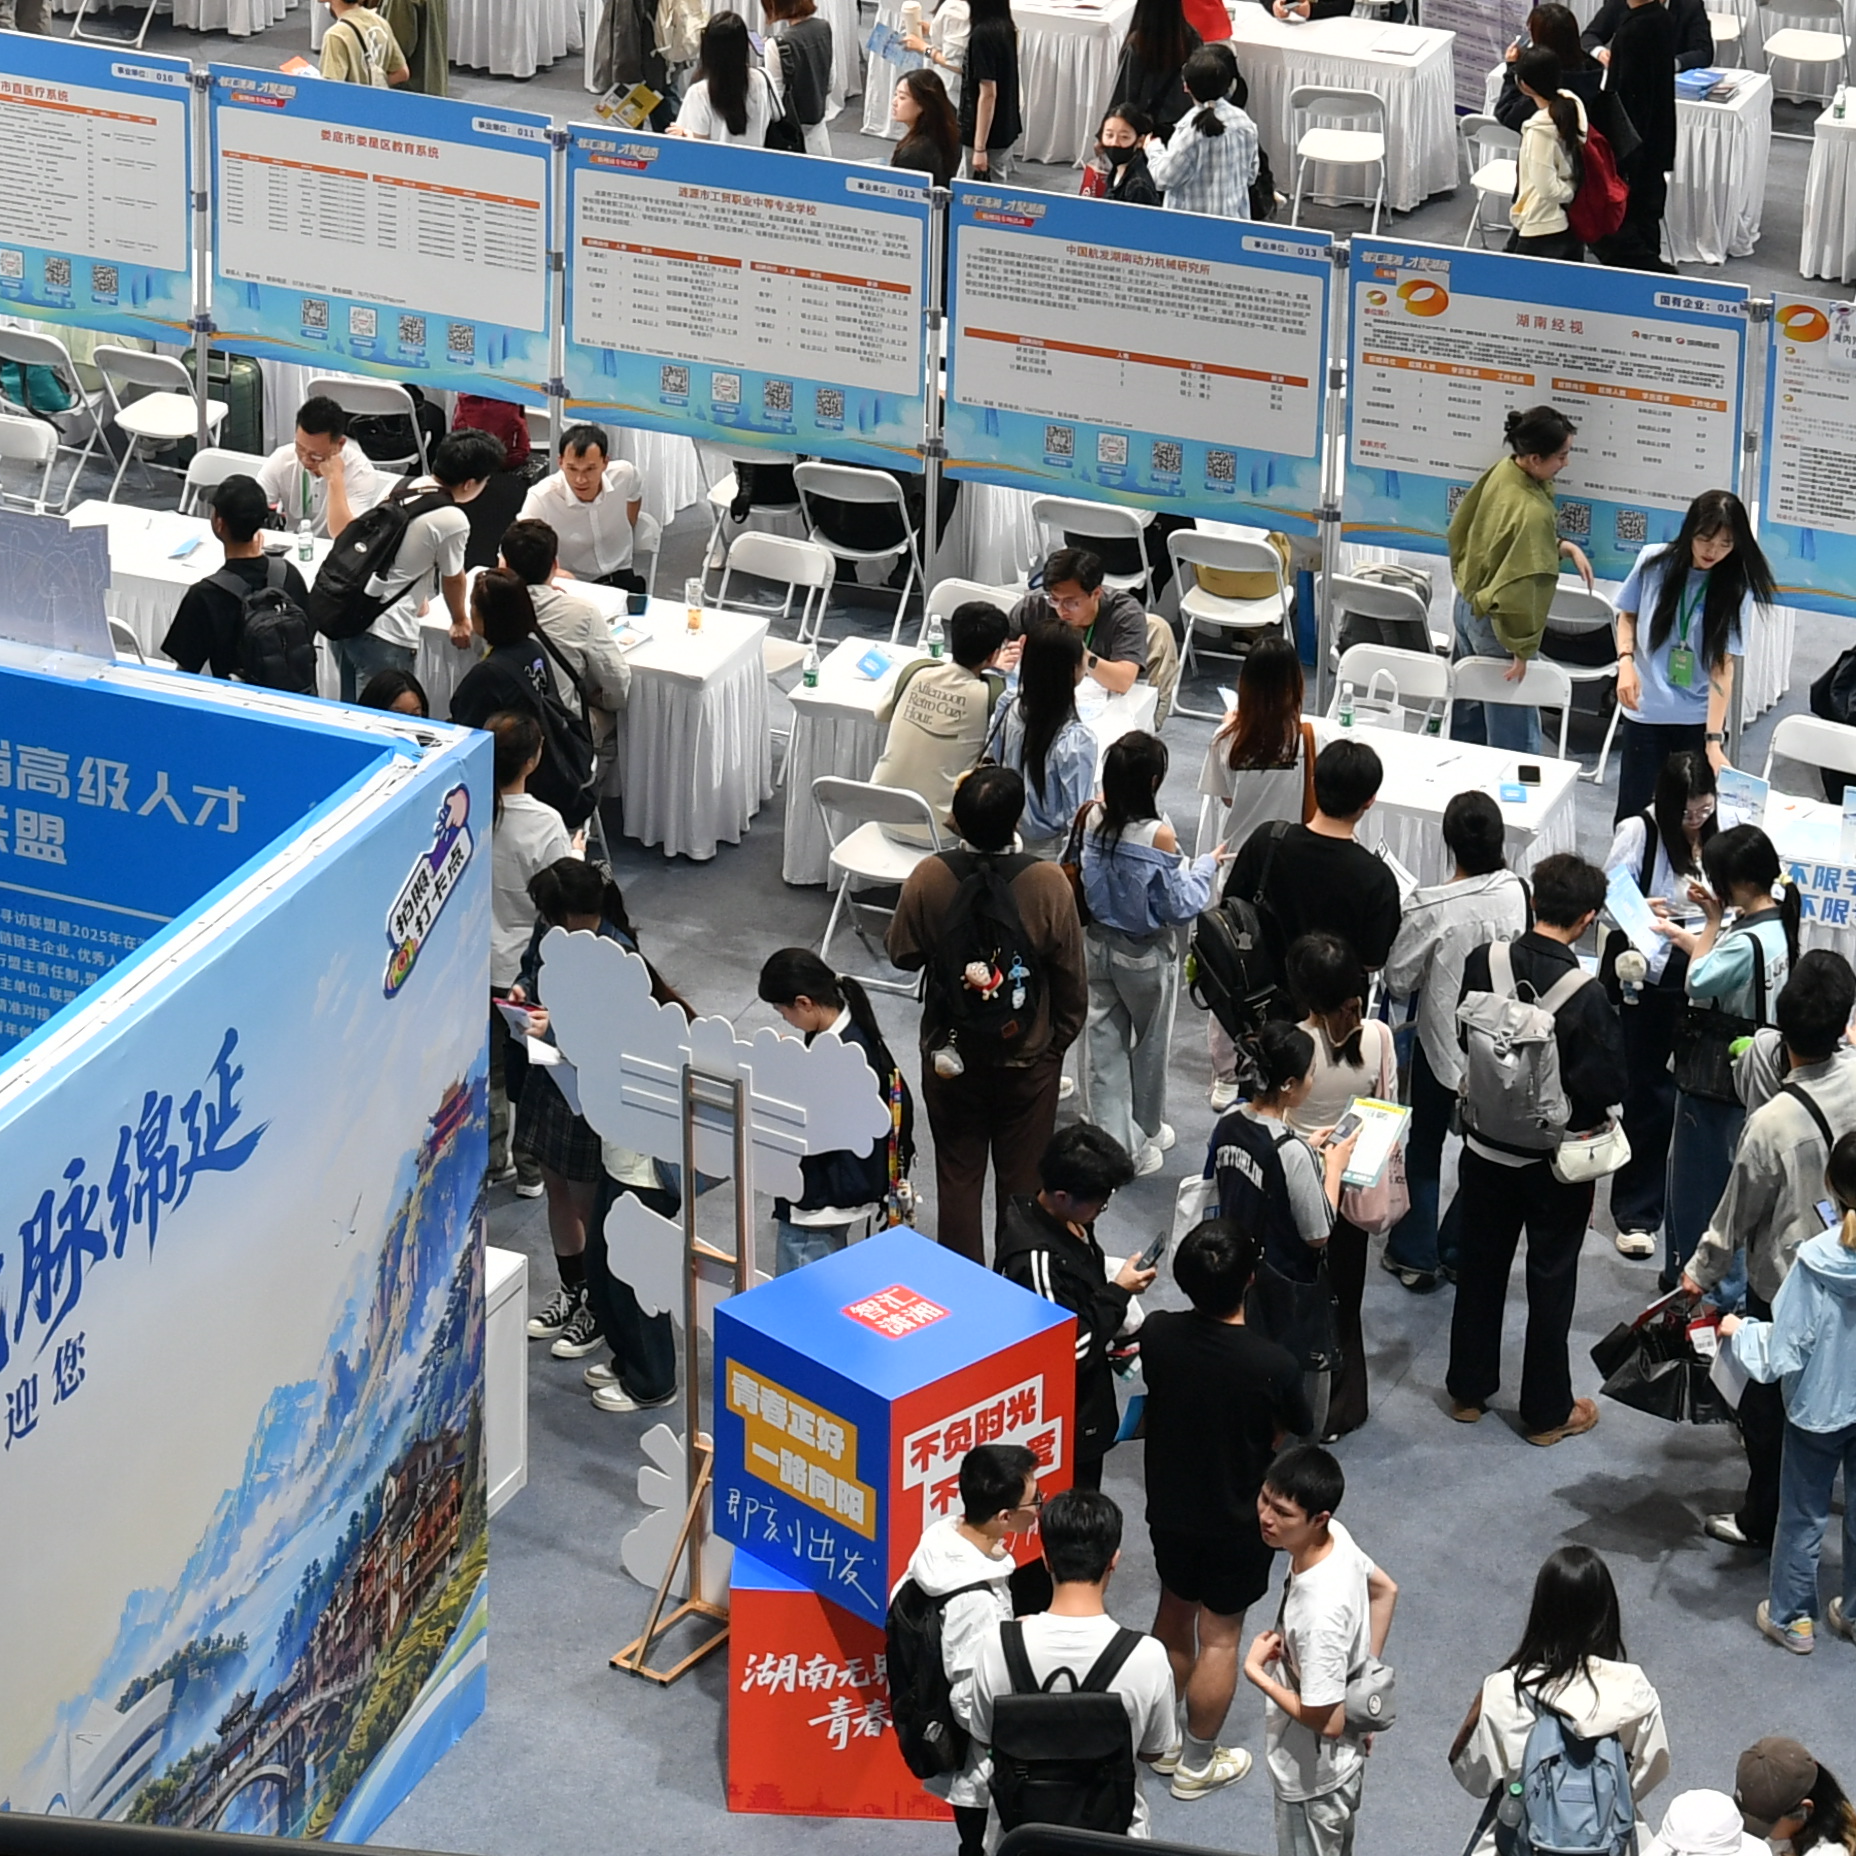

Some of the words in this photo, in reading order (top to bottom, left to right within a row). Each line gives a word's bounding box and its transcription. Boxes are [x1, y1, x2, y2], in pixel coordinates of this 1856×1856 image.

[320, 129, 440, 159] 娄底市娄星区教育系统
[678, 186, 817, 215] 涟源市工贸职业中等专业学校
[1066, 245, 1210, 275] 中国航发湖南动力机械研究所
[1516, 313, 1584, 335] 湖南经视
[1660, 294, 1738, 314] 国有企业：014
[396, 867, 429, 936] 拍照
[415, 844, 465, 937] 打卡点
[850, 1287, 918, 1321] 智汇
[876, 1301, 946, 1337] 潇湘
[731, 1369, 846, 1463] 青春正好
[909, 1387, 1040, 1474] 不负时光
[752, 1441, 866, 1525] 一路向阳
[930, 1427, 1058, 1515] 不爱
[727, 1487, 879, 1610] 即刻出发
[808, 1696, 893, 1751] 青春
